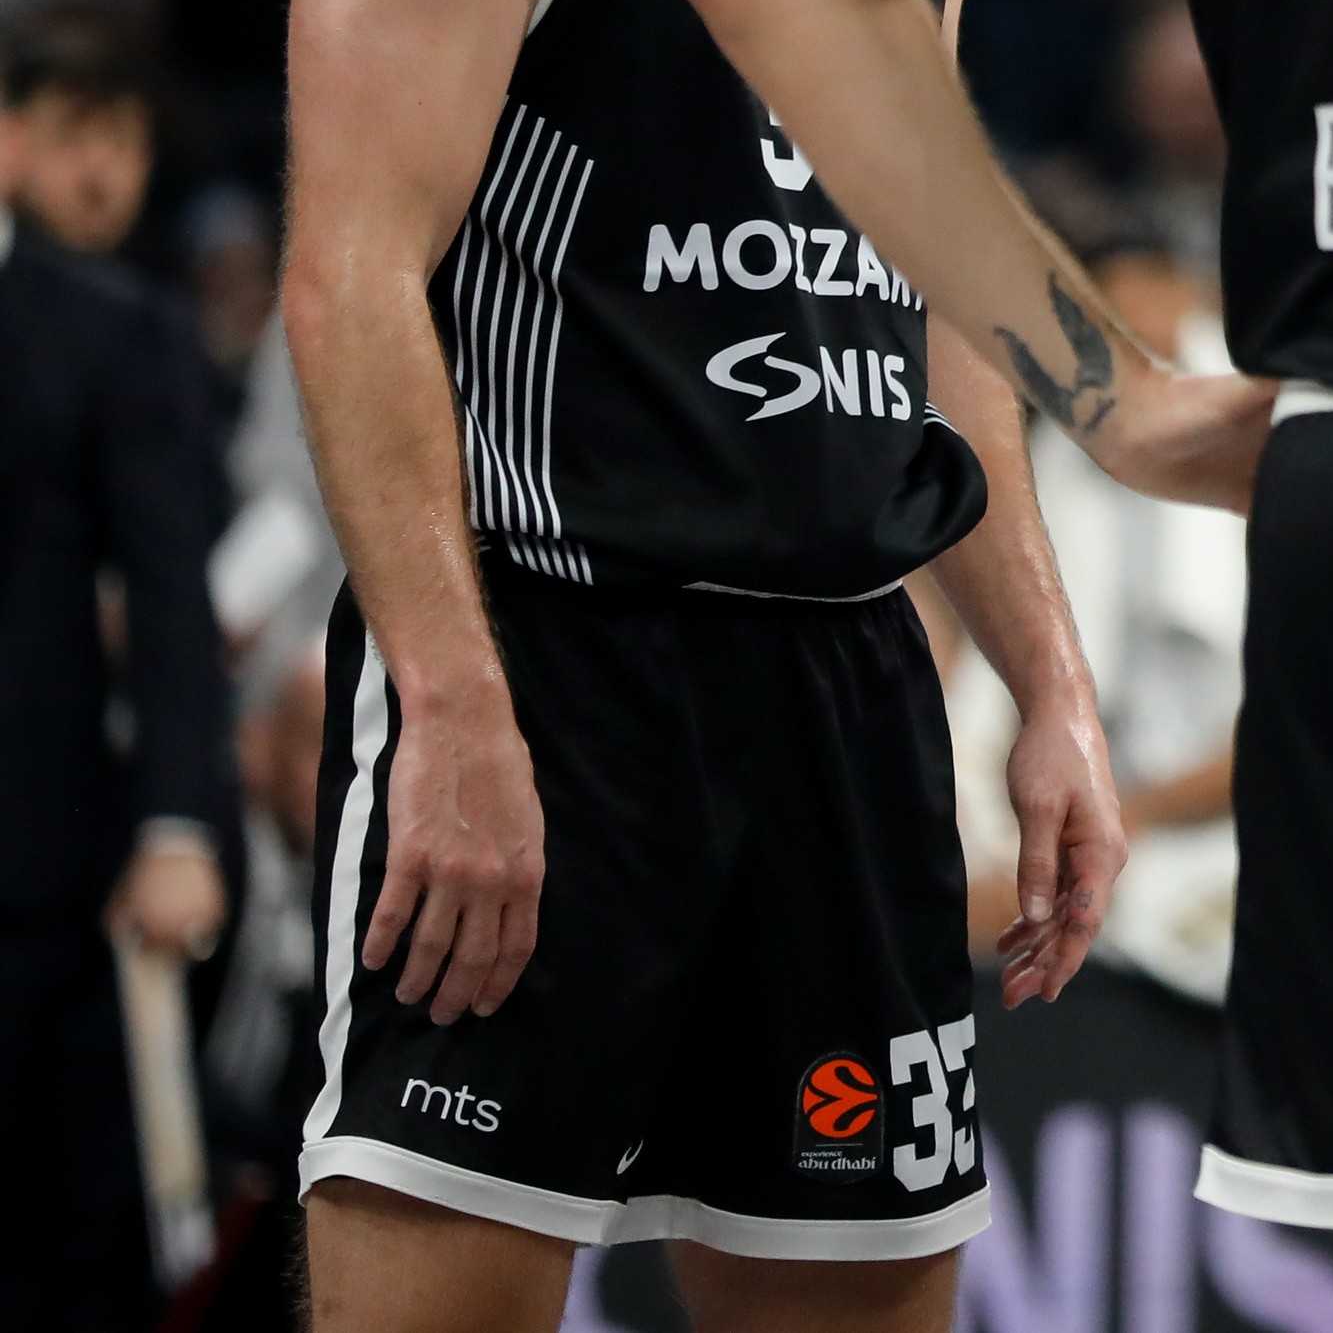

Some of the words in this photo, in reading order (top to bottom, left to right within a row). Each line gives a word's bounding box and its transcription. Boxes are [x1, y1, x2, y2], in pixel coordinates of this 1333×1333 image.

[818, 345, 911, 421] NIS
[400, 1078, 502, 1133] mts
[798, 1158, 829, 1170] abu
[831, 1156, 876, 1170] dhabi
